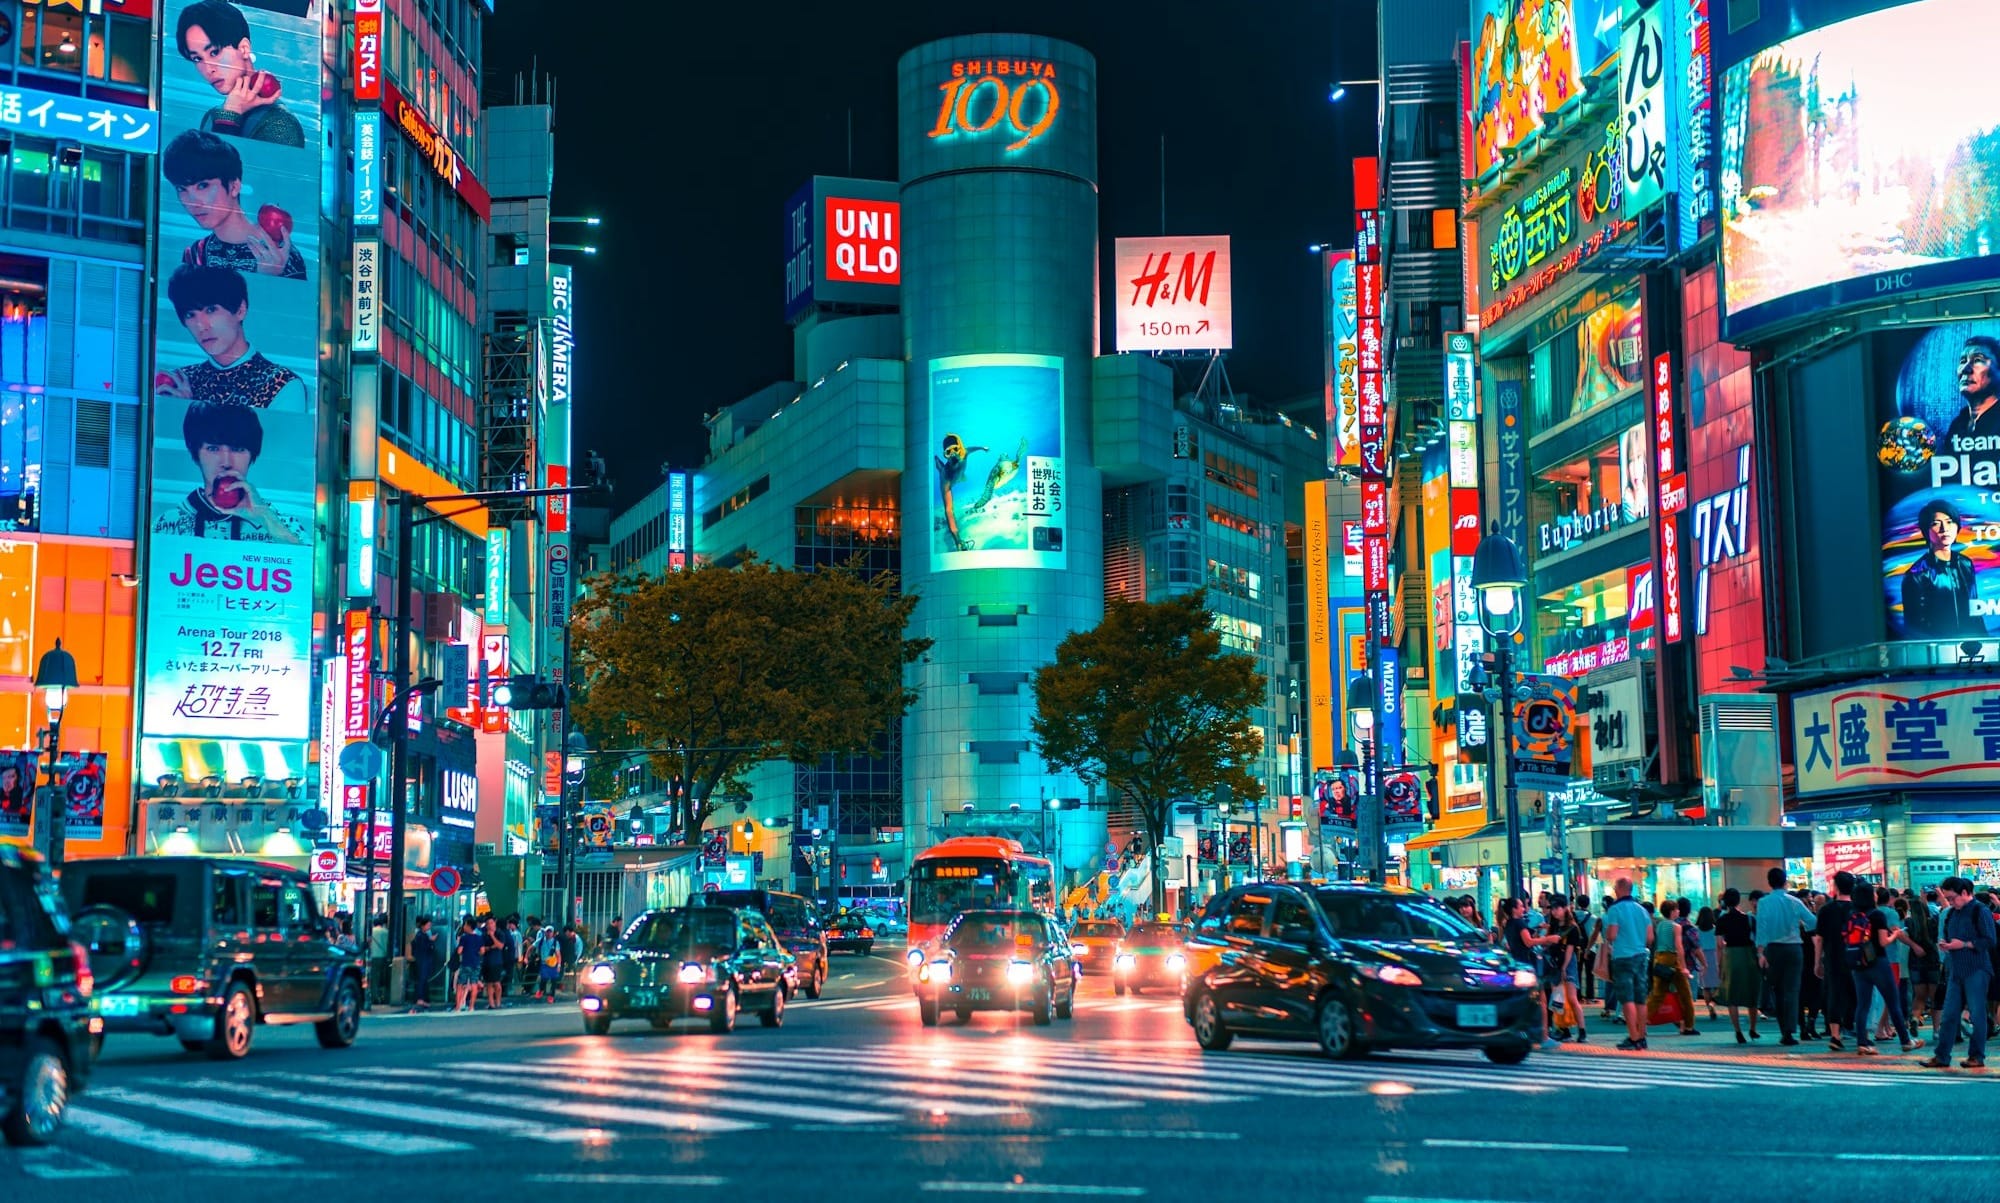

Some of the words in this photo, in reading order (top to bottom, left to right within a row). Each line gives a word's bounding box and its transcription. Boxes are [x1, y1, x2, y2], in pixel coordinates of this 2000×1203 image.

[359, 35, 377, 88] ガスト
[952, 60, 1057, 79] SHIBUYA
[927, 75, 1060, 152] 109
[791, 201, 808, 253] THE
[835, 208, 893, 241] UNI
[786, 244, 812, 305] PRIME
[835, 242, 898, 277] QLO
[358, 248, 373, 343] 渋谷駅前ビル
[552, 275, 568, 310] BIC
[1132, 249, 1216, 308] H&M
[1875, 273, 1912, 293] DHC
[1140, 320, 1190, 336] 150m
[1031, 467, 1062, 481] 世界に
[1931, 454, 2000, 488] Pla
[1454, 514, 1478, 530] JTB
[1540, 501, 1619, 551] Euphoria
[169, 553, 292, 593] Jesus
[242, 554, 260, 563] NEW
[263, 556, 292, 565] SINGLE
[551, 576, 564, 628] 調剤薬局
[177, 625, 215, 638] Arena
[221, 628, 248, 640] Tour
[251, 630, 282, 641] 2018
[201, 641, 240, 657] 12.7
[244, 649, 263, 659] FRI
[165, 659, 291, 676] さいたまスーパーアリーナ
[1383, 660, 1395, 713] MIZUHO
[443, 769, 477, 813] LUSH
